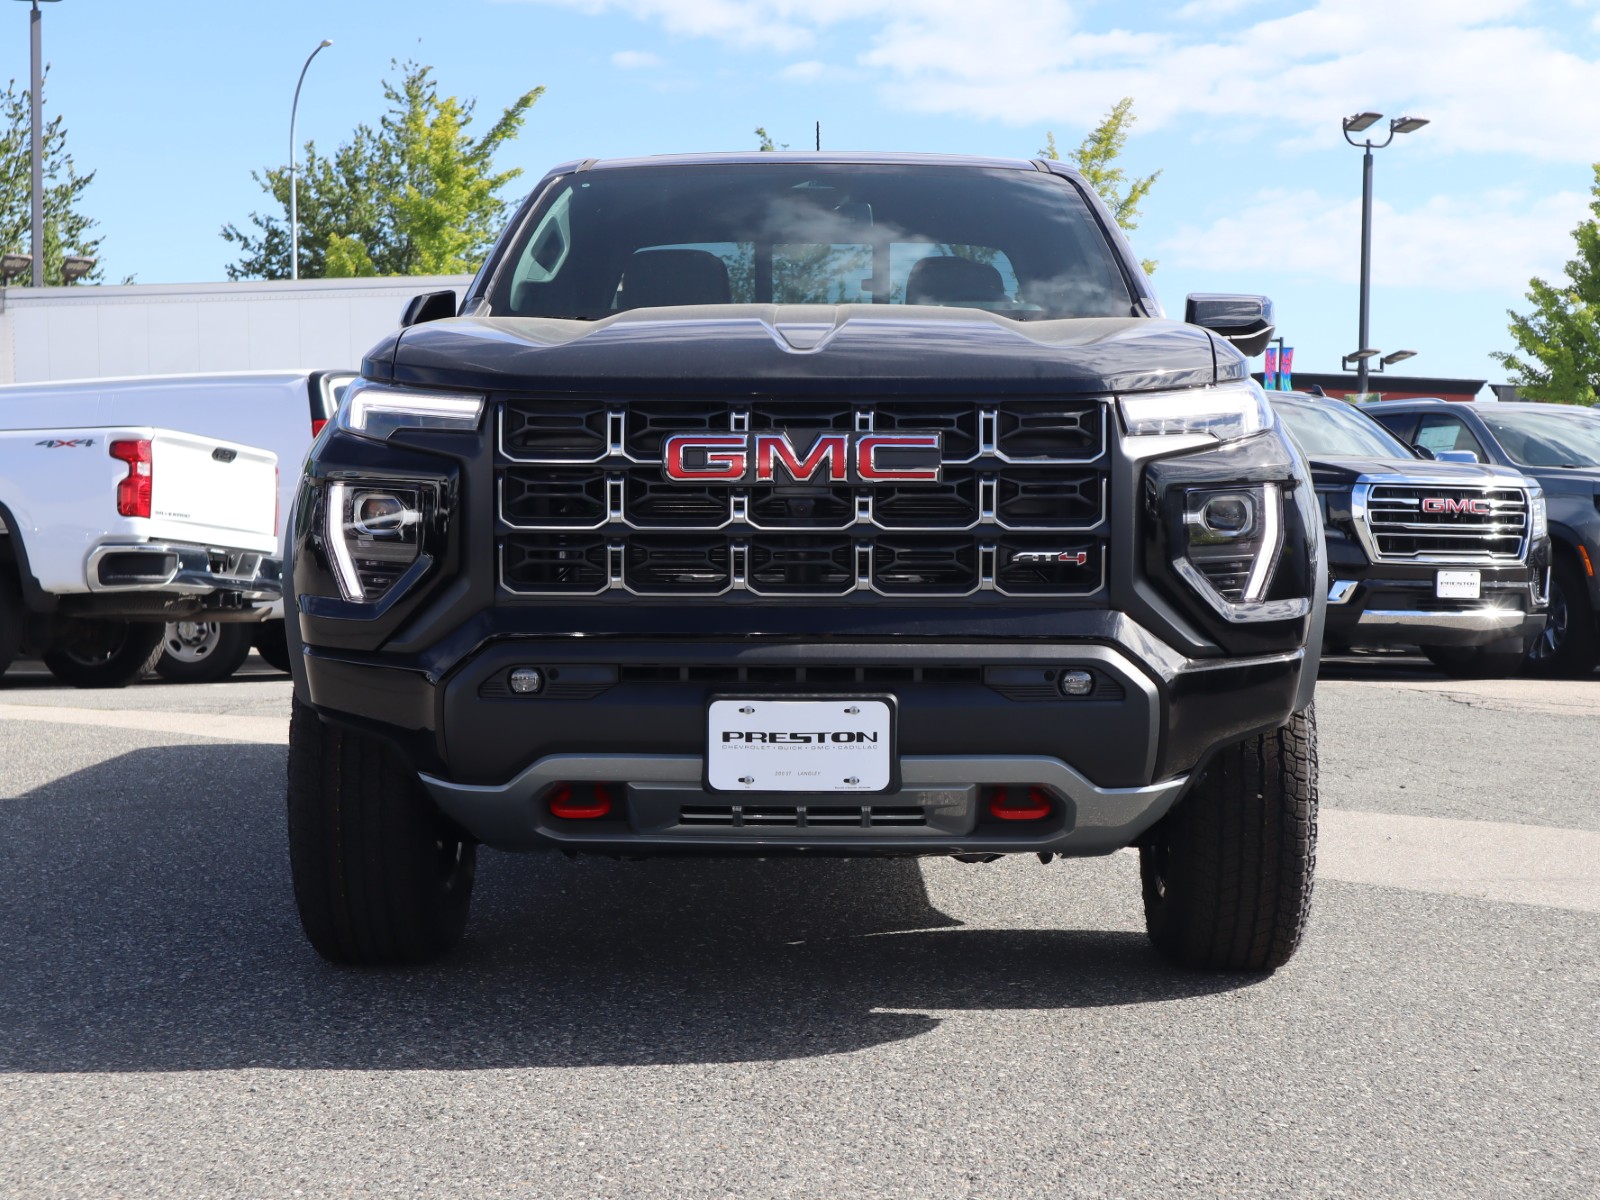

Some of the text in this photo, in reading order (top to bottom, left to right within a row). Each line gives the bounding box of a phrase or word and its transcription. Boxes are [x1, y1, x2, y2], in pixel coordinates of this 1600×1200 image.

[664, 433, 942, 483] GMC
[1422, 498, 1490, 514] GMC
[1012, 552, 1087, 566] AT4
[722, 731, 878, 744] PRESTON
